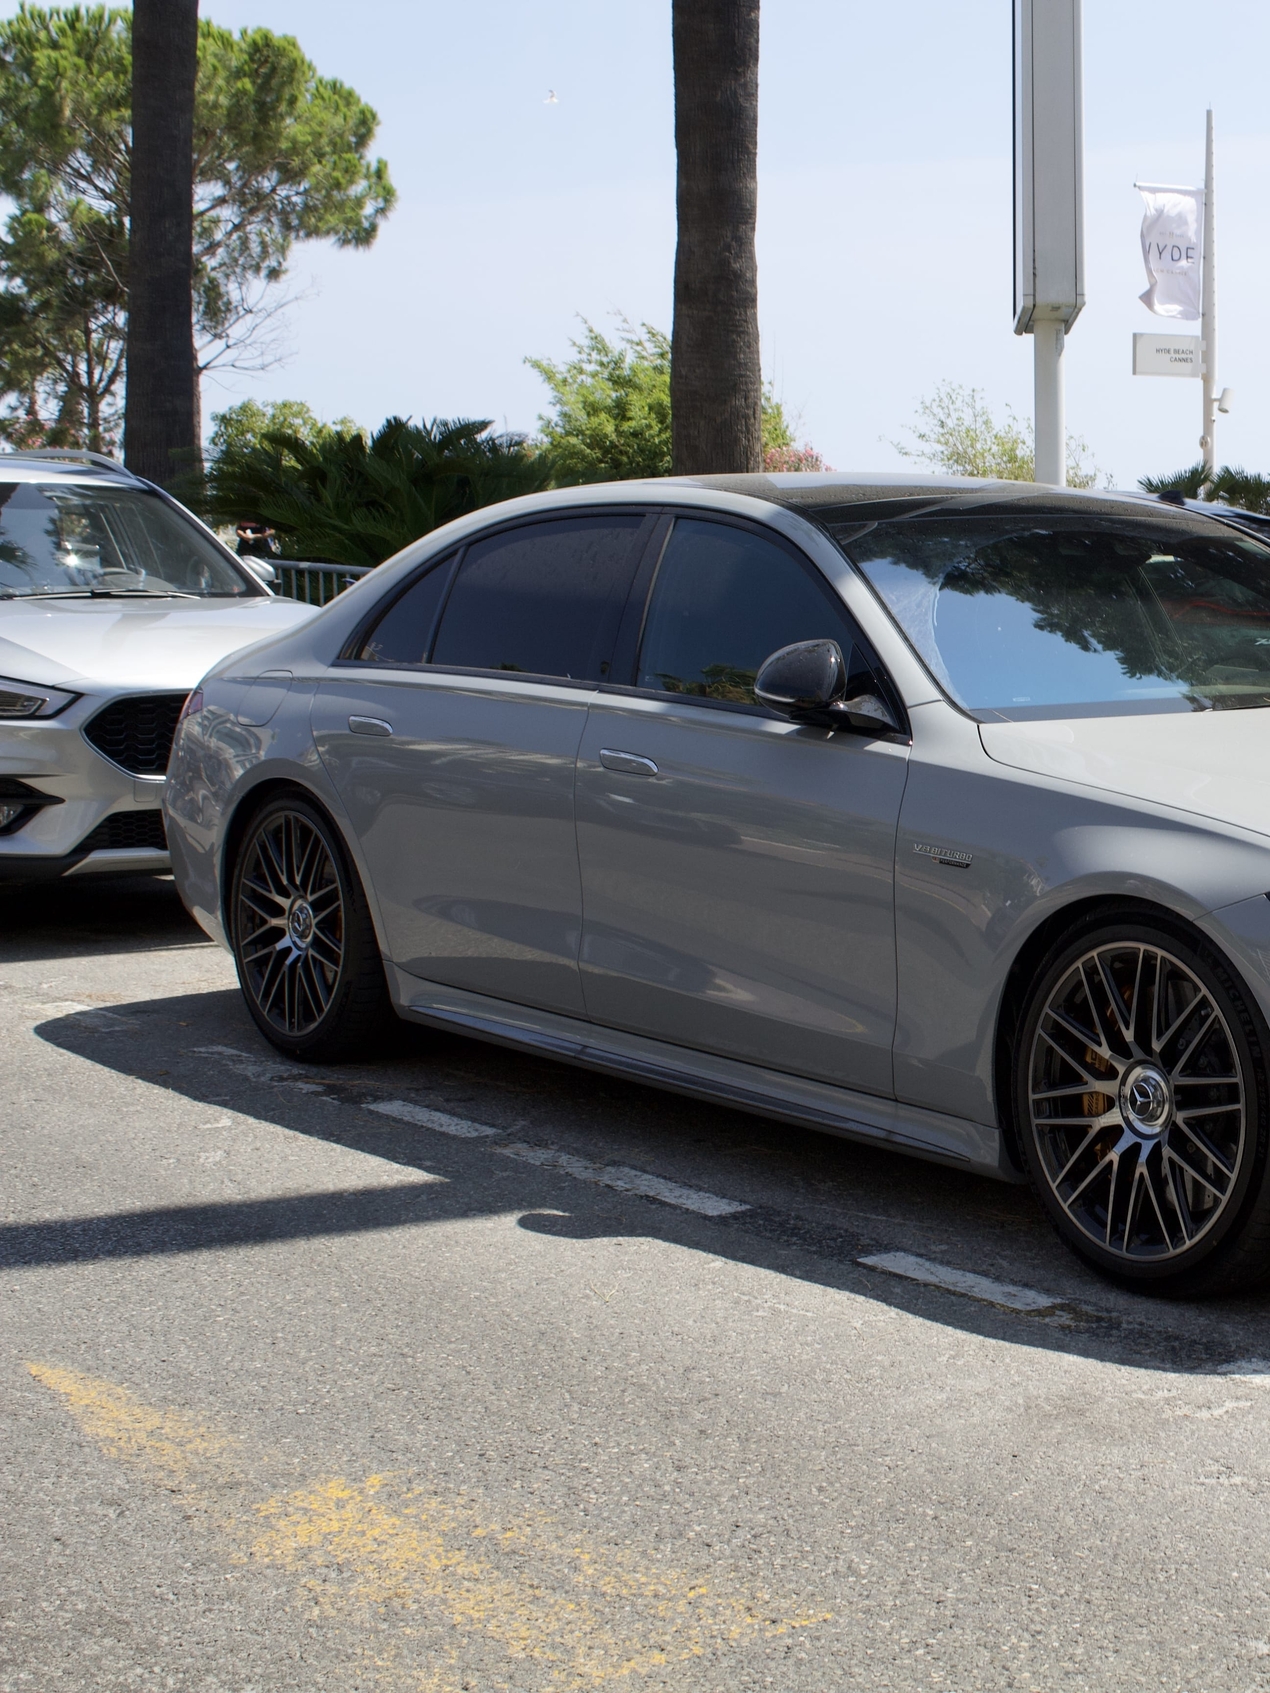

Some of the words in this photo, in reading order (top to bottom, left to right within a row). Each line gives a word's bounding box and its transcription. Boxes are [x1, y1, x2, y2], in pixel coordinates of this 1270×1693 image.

[1155, 347, 1172, 356] HYDE
[1173, 348, 1194, 356] BEACH
[1169, 356, 1194, 364] CANNES
[931, 846, 973, 862] BITURBO
[1215, 966, 1263, 1058] MICHELIN
